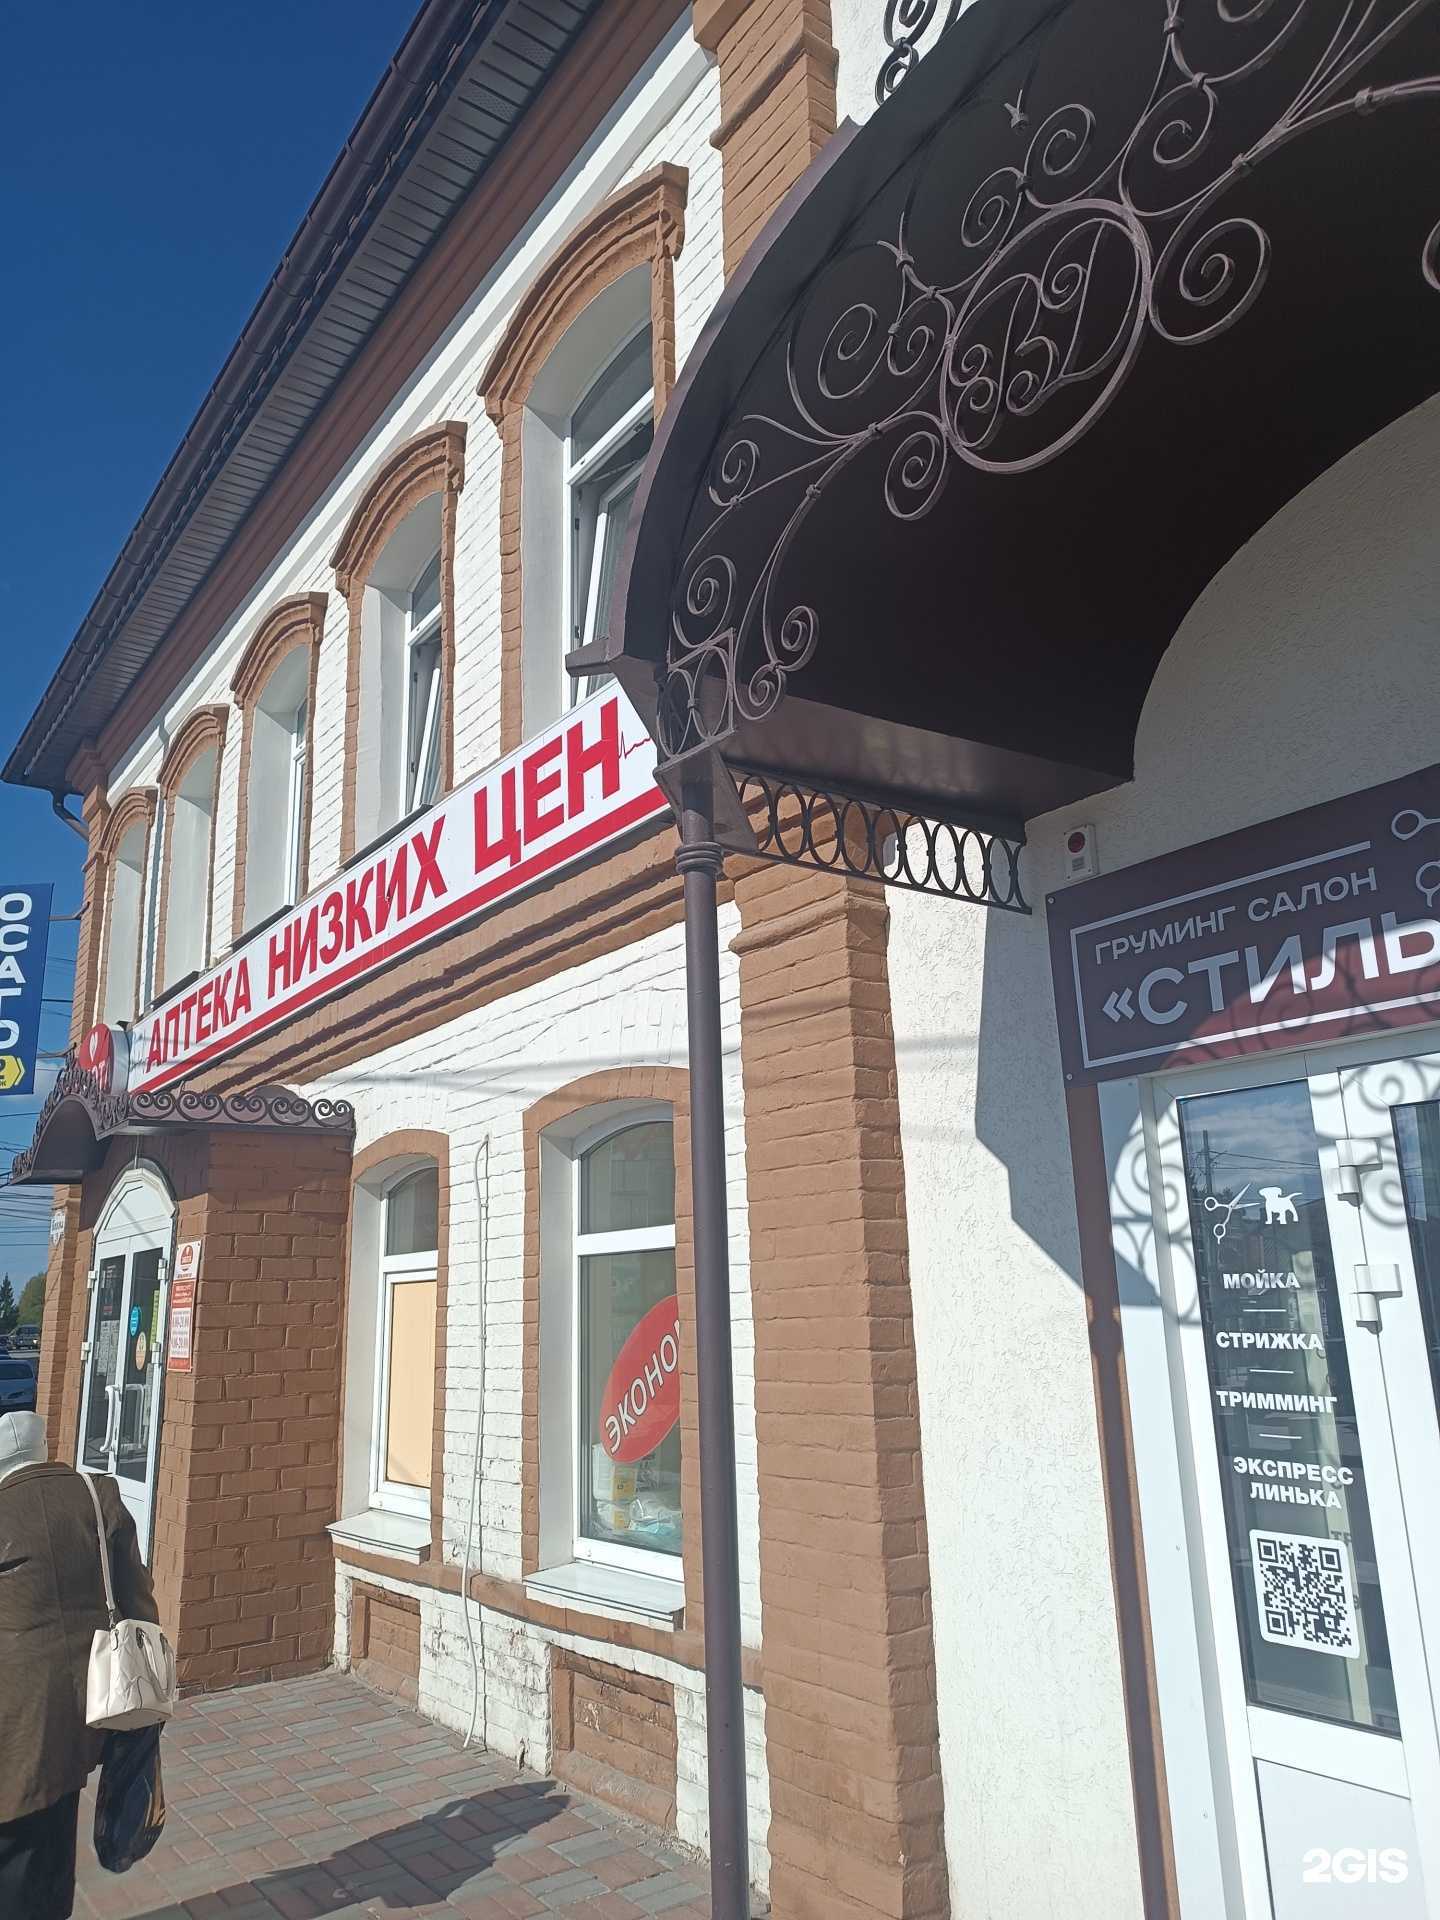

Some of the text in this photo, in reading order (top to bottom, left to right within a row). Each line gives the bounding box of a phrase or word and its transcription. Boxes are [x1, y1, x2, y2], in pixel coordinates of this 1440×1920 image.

[146, 697, 621, 1073] АПТЕКА НИЗКИХ ЦЕН
[1095, 867, 1378, 965] ГРУМИНГ САЛОН
[1223, 1268, 1301, 1289] МОЙКА
[1215, 1331, 1324, 1351] СТРИЖКА
[604, 1319, 680, 1454] ЭКОНО
[1216, 1390, 1338, 1414] ТРИММИНГ
[1233, 1456, 1354, 1486] ЭКСПРЕСС
[1250, 1482, 1342, 1509] ЛИНЬКА
